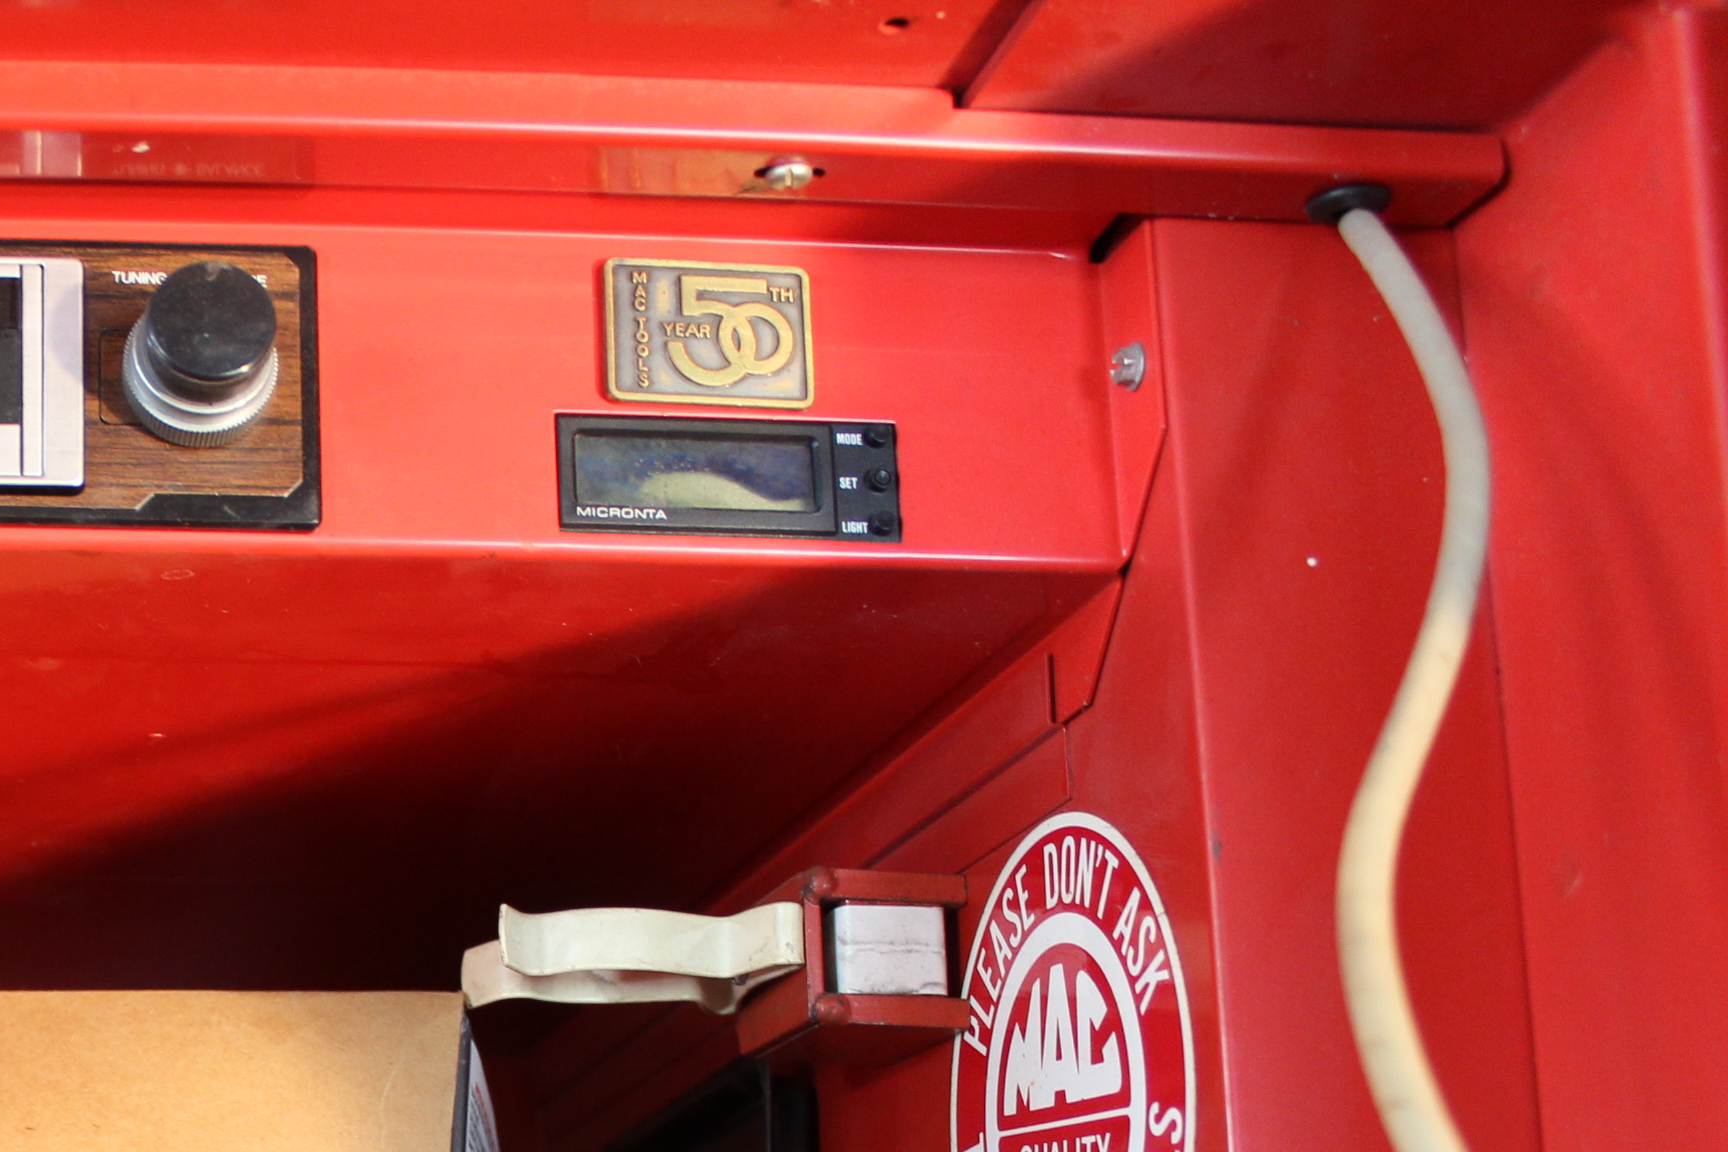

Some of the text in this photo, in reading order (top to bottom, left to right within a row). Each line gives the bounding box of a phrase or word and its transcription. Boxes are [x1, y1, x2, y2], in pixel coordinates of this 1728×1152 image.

[630, 270, 651, 390] MAC TOOLS
[662, 322, 712, 340] YEAR
[836, 432, 863, 447] MODE
[839, 476, 858, 491] SET
[576, 506, 668, 521] MICRONTA
[841, 520, 869, 535] LIGHT
[962, 834, 1170, 1058] PLEASE DON'T ASK
[1003, 962, 1124, 1118] MAC
